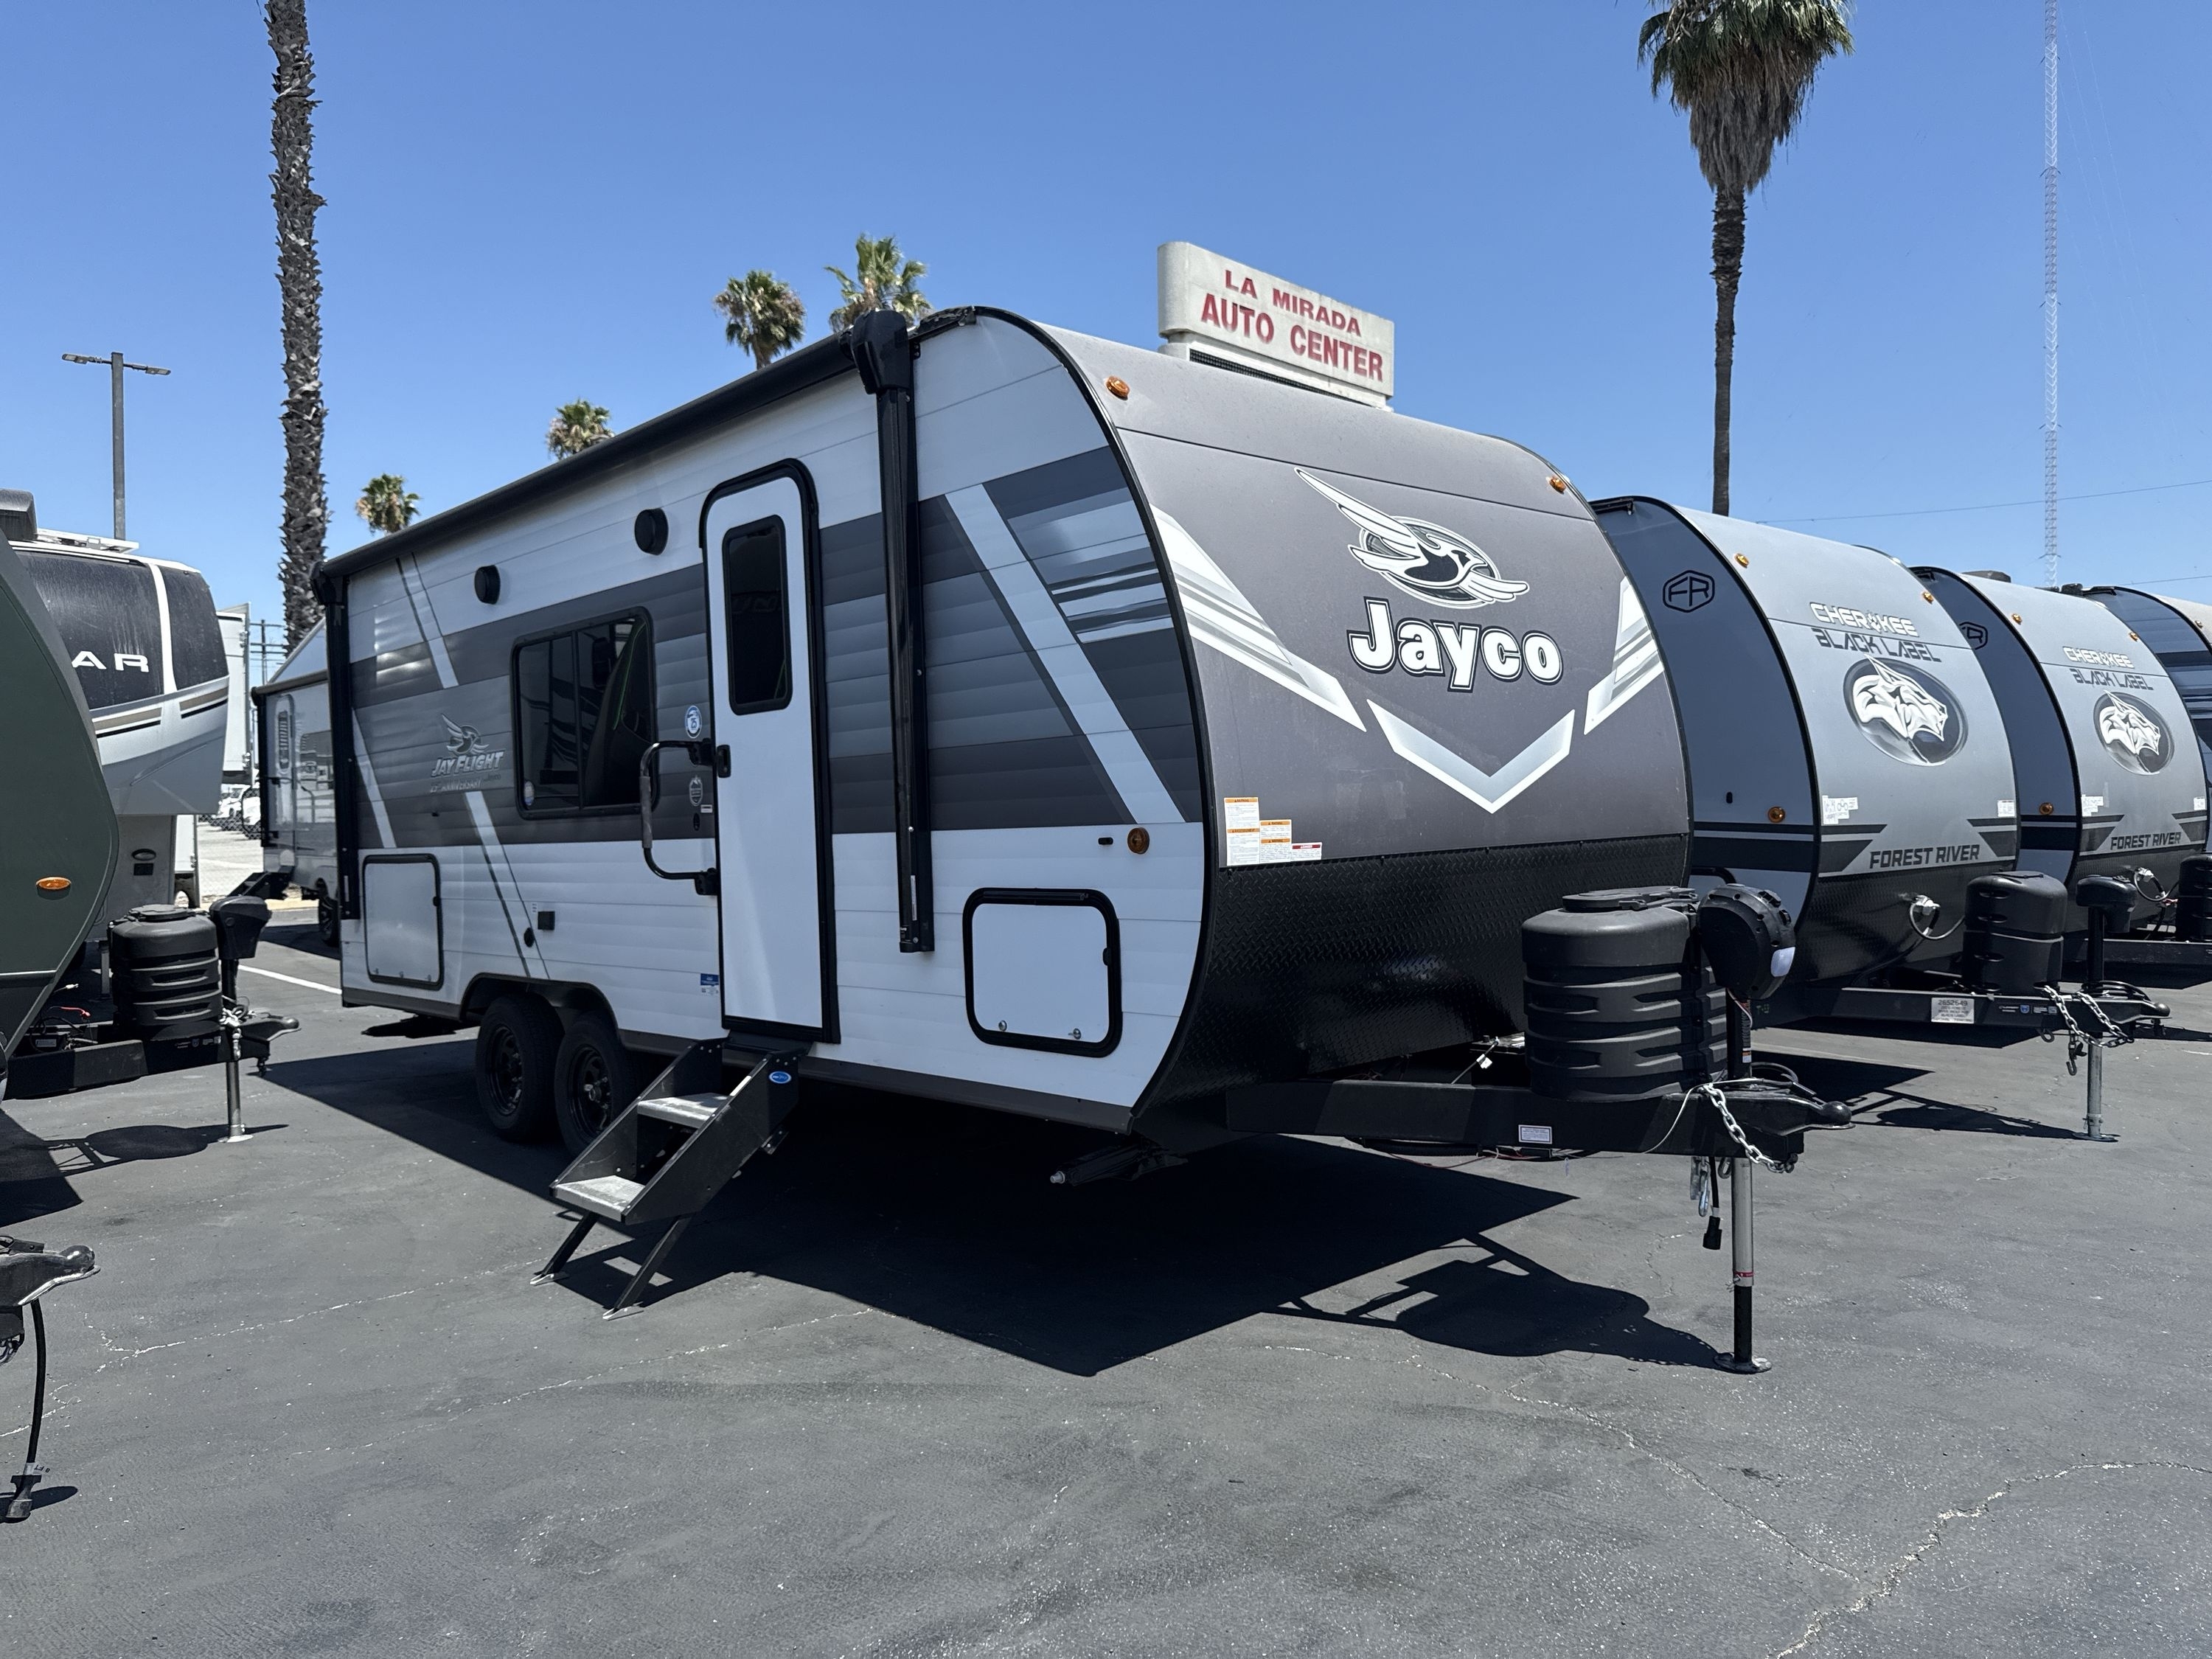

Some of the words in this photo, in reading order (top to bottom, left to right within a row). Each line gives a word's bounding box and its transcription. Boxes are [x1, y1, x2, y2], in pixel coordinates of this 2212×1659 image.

[1225, 269, 1258, 299] LA
[1273, 288, 1362, 338] MIRADA
[1200, 293, 1275, 345] AUTO
[1290, 324, 1383, 383] CENTER
[1809, 602, 1920, 638] CHEROKEE
[1346, 596, 1564, 693] Jayco
[1811, 627, 1883, 655] BLACK
[1880, 638, 1942, 662] LABEL
[2062, 646, 2135, 669] CHEROKEE
[2069, 668, 2116, 687] BLACK
[2112, 672, 2154, 690] LABEL
[431, 757, 457, 778] JAY
[454, 751, 505, 774] FLIGHT
[2110, 834, 2152, 850] FOREST
[2152, 831, 2182, 846] RIVER
[1869, 847, 1933, 869] FOREST
[1935, 844, 1980, 863] RIVER
